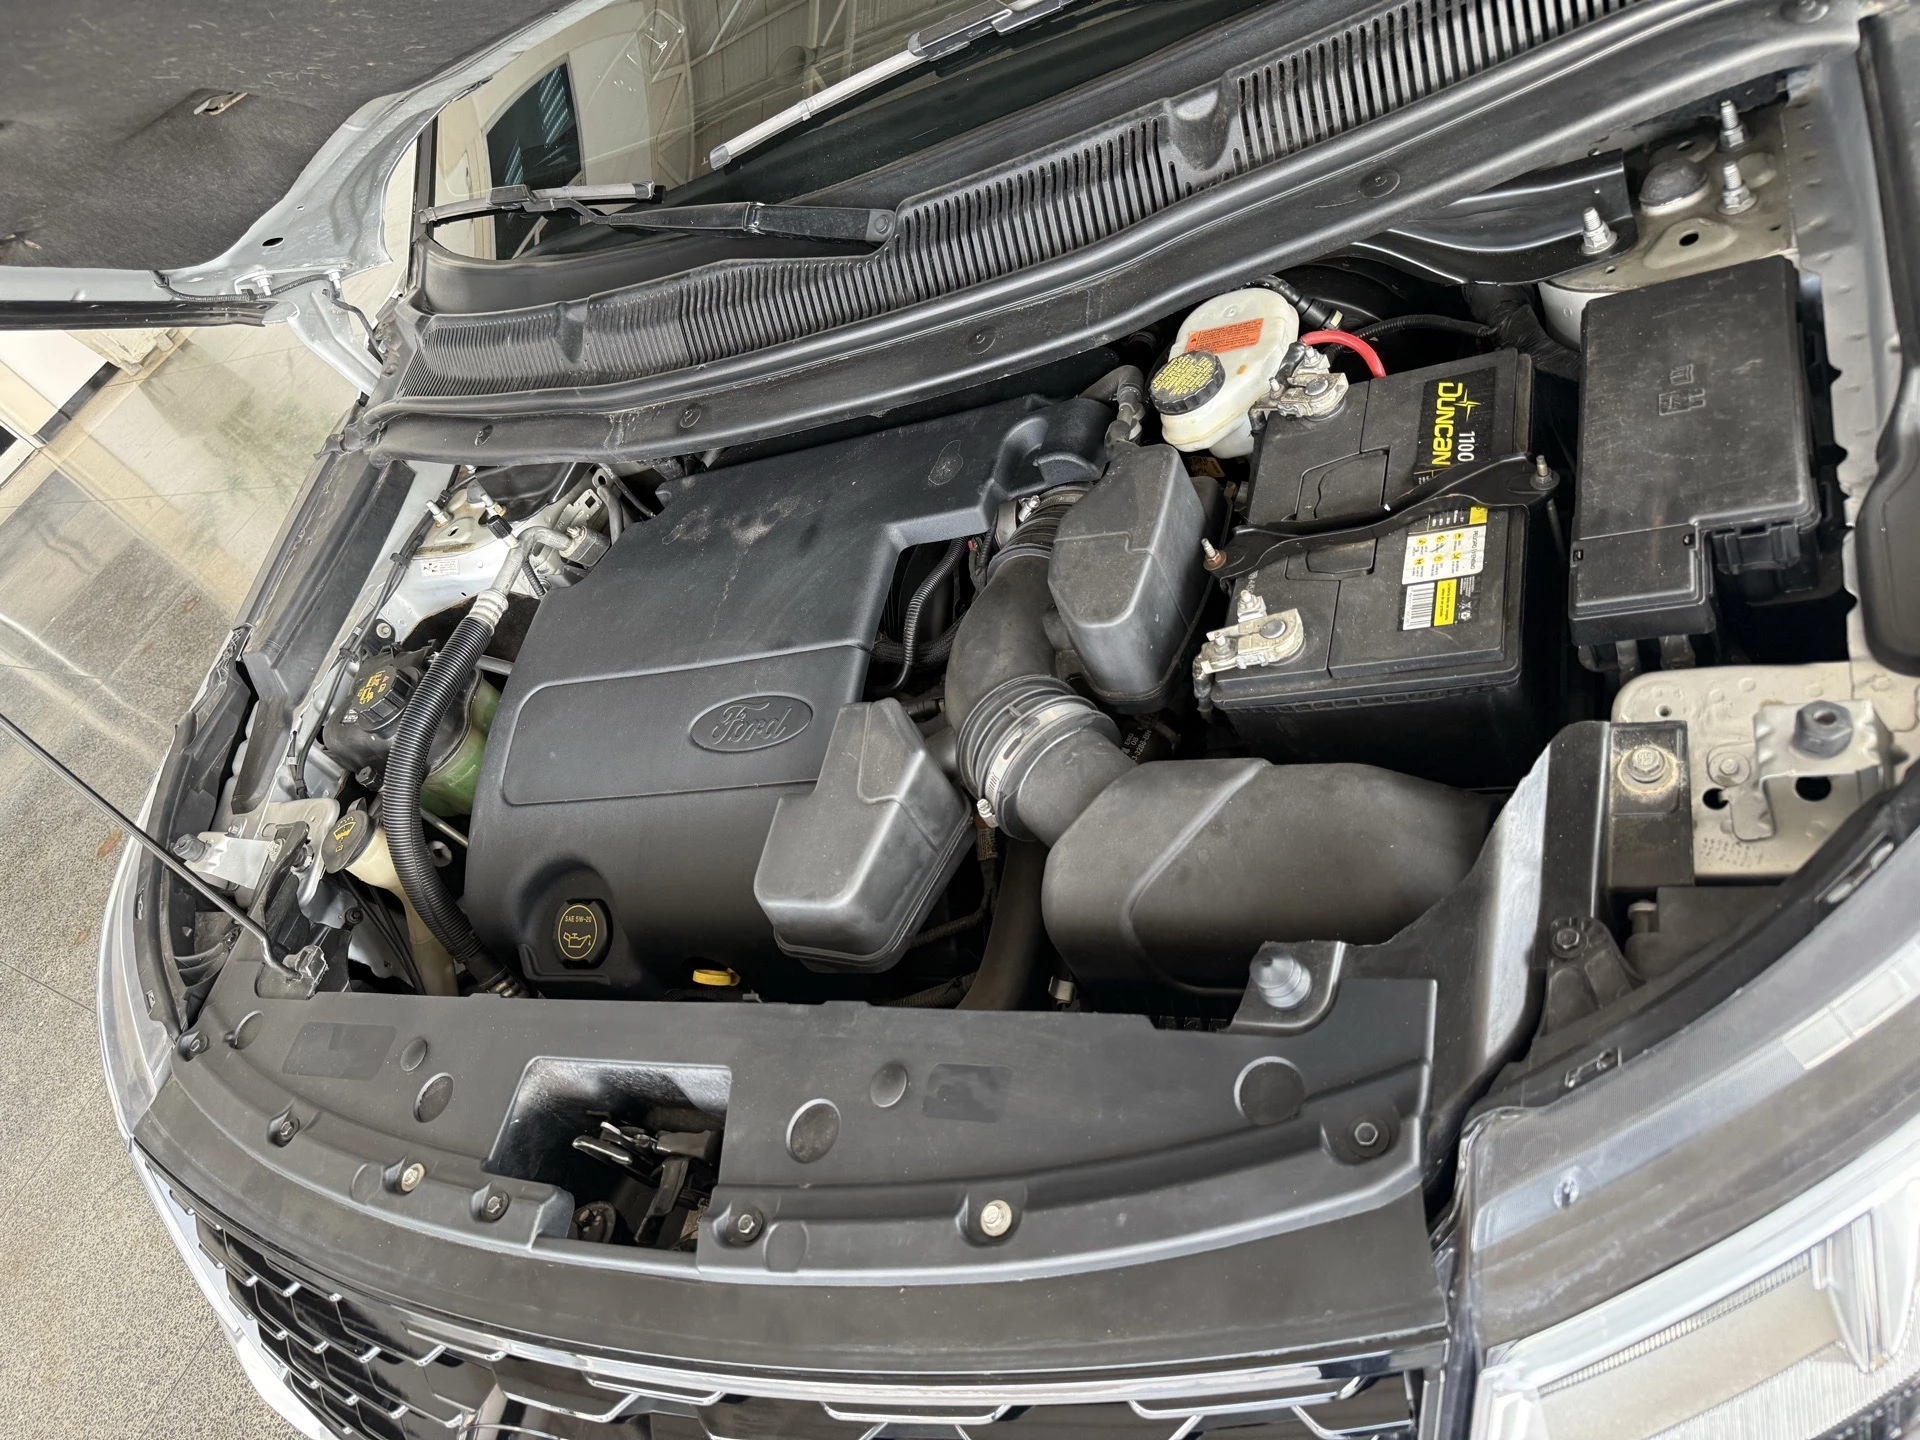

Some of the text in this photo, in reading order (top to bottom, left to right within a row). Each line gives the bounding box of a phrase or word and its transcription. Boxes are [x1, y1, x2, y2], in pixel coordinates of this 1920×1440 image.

[1457, 431, 1476, 462] 1100
[711, 702, 793, 745] Ford
[564, 915, 592, 923] SAE 5W-20
